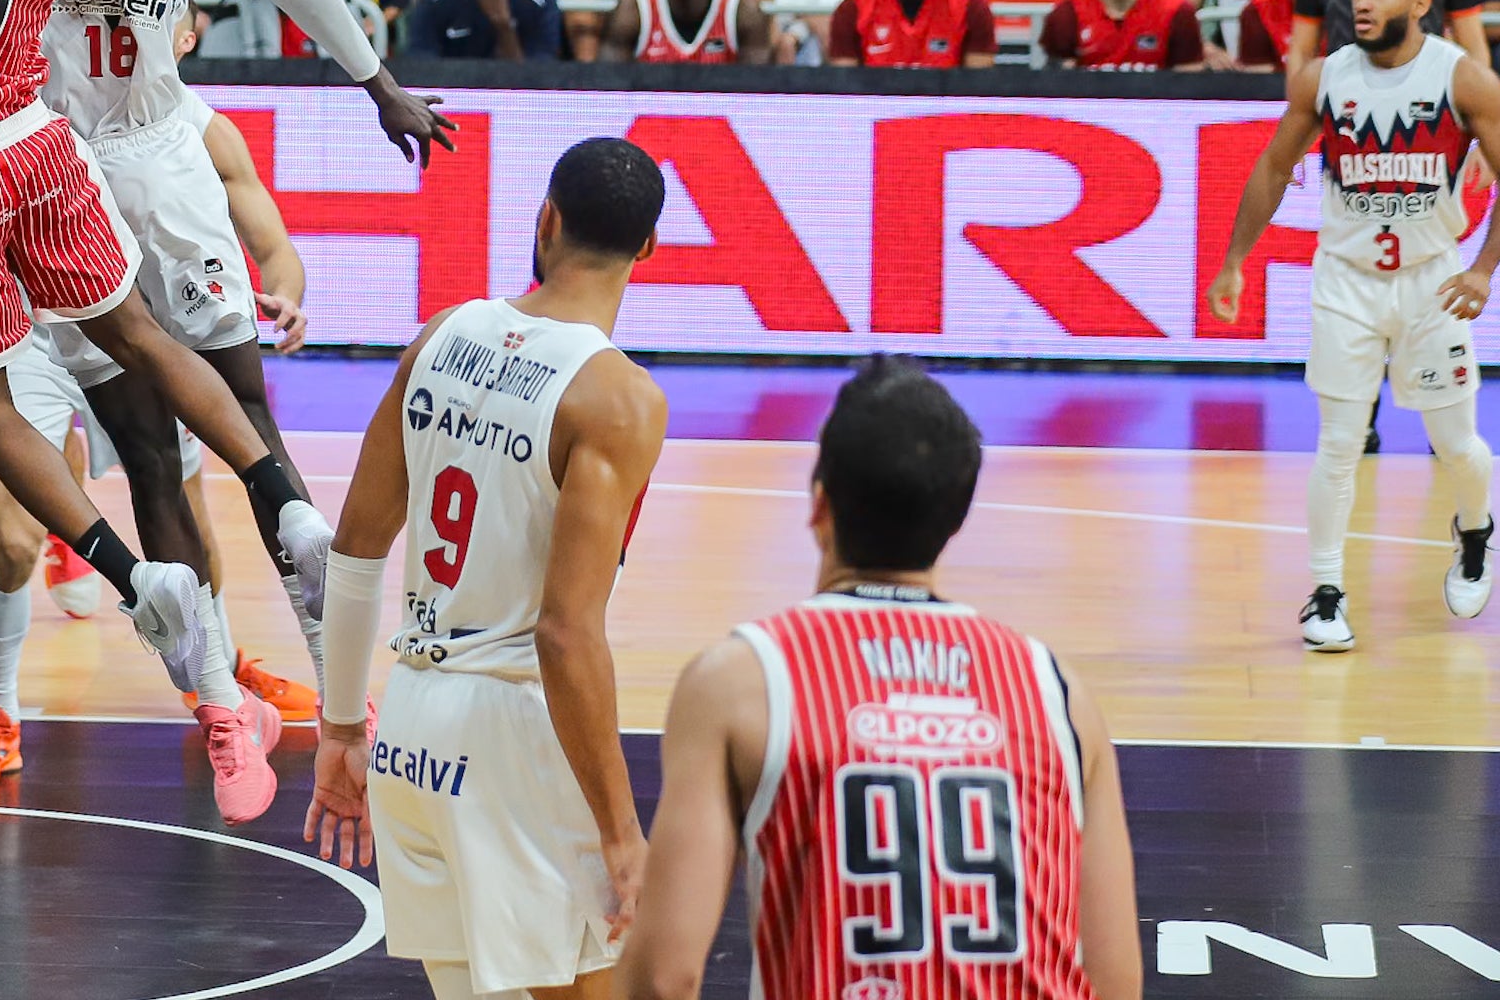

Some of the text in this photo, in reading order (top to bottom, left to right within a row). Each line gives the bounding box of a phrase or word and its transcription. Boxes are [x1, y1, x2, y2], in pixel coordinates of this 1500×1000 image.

[84, 24, 138, 78] 18
[1373, 232, 1401, 272] 3
[436, 407, 533, 463] AMUTIO
[423, 464, 479, 591] 9
[834, 763, 1024, 964] 99
